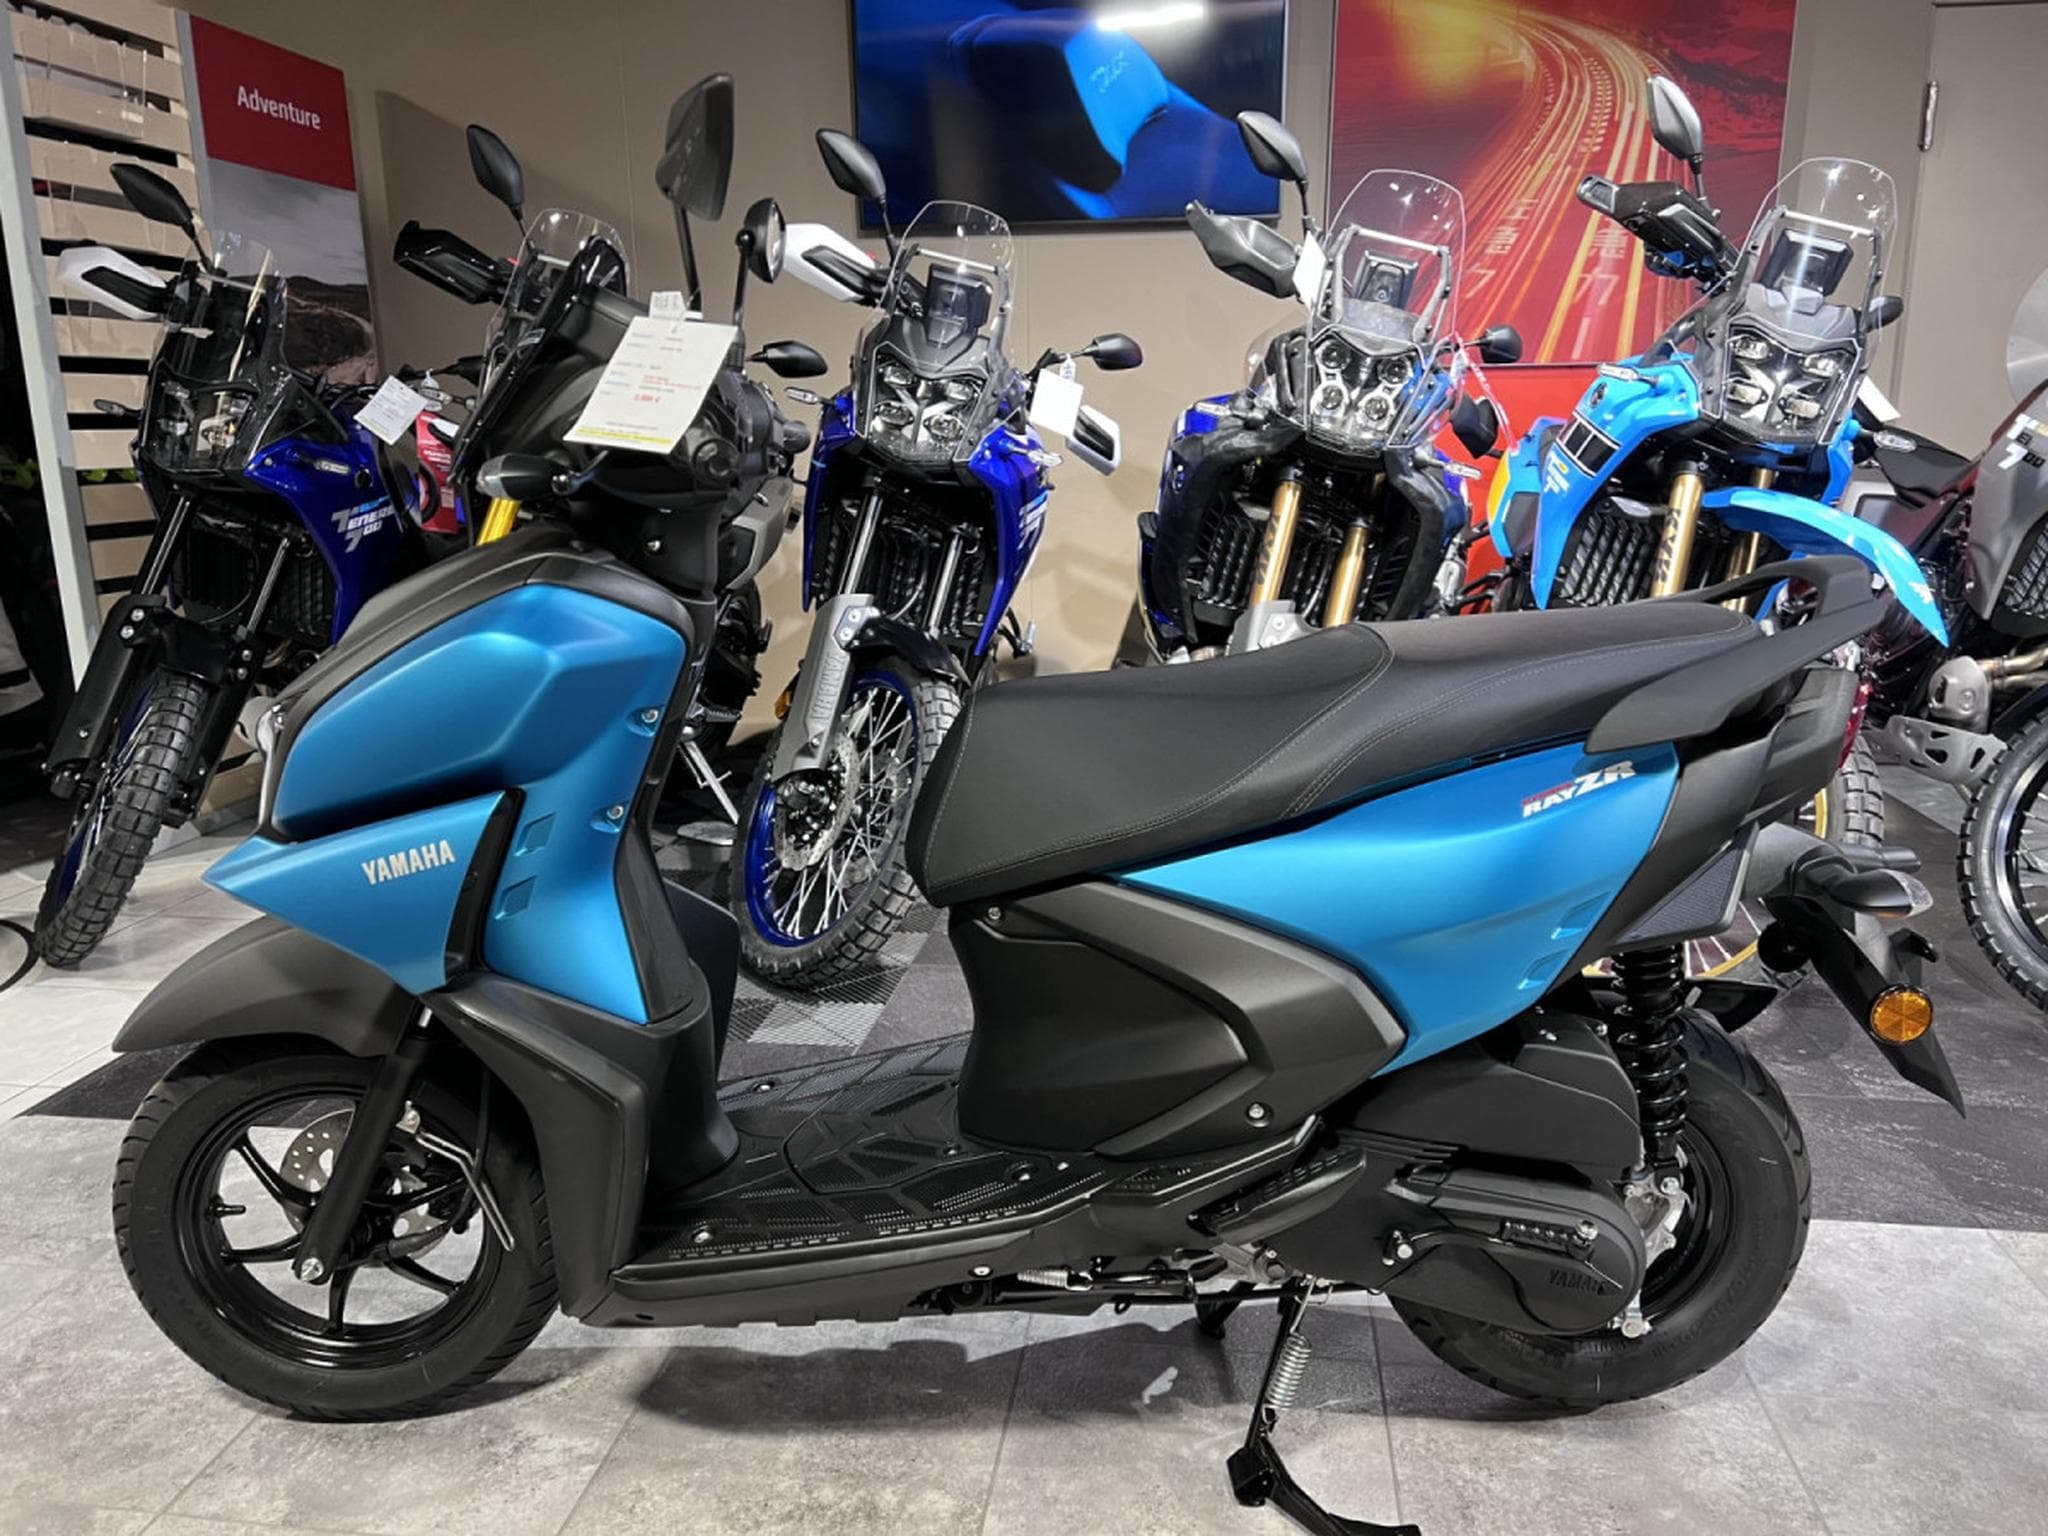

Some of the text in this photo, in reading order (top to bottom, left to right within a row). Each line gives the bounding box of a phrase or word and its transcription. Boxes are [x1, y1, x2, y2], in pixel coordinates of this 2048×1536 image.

[237, 84, 321, 130] Adventure
[810, 654, 847, 720] YAMAHA
[361, 839, 456, 886] YAMAHA
